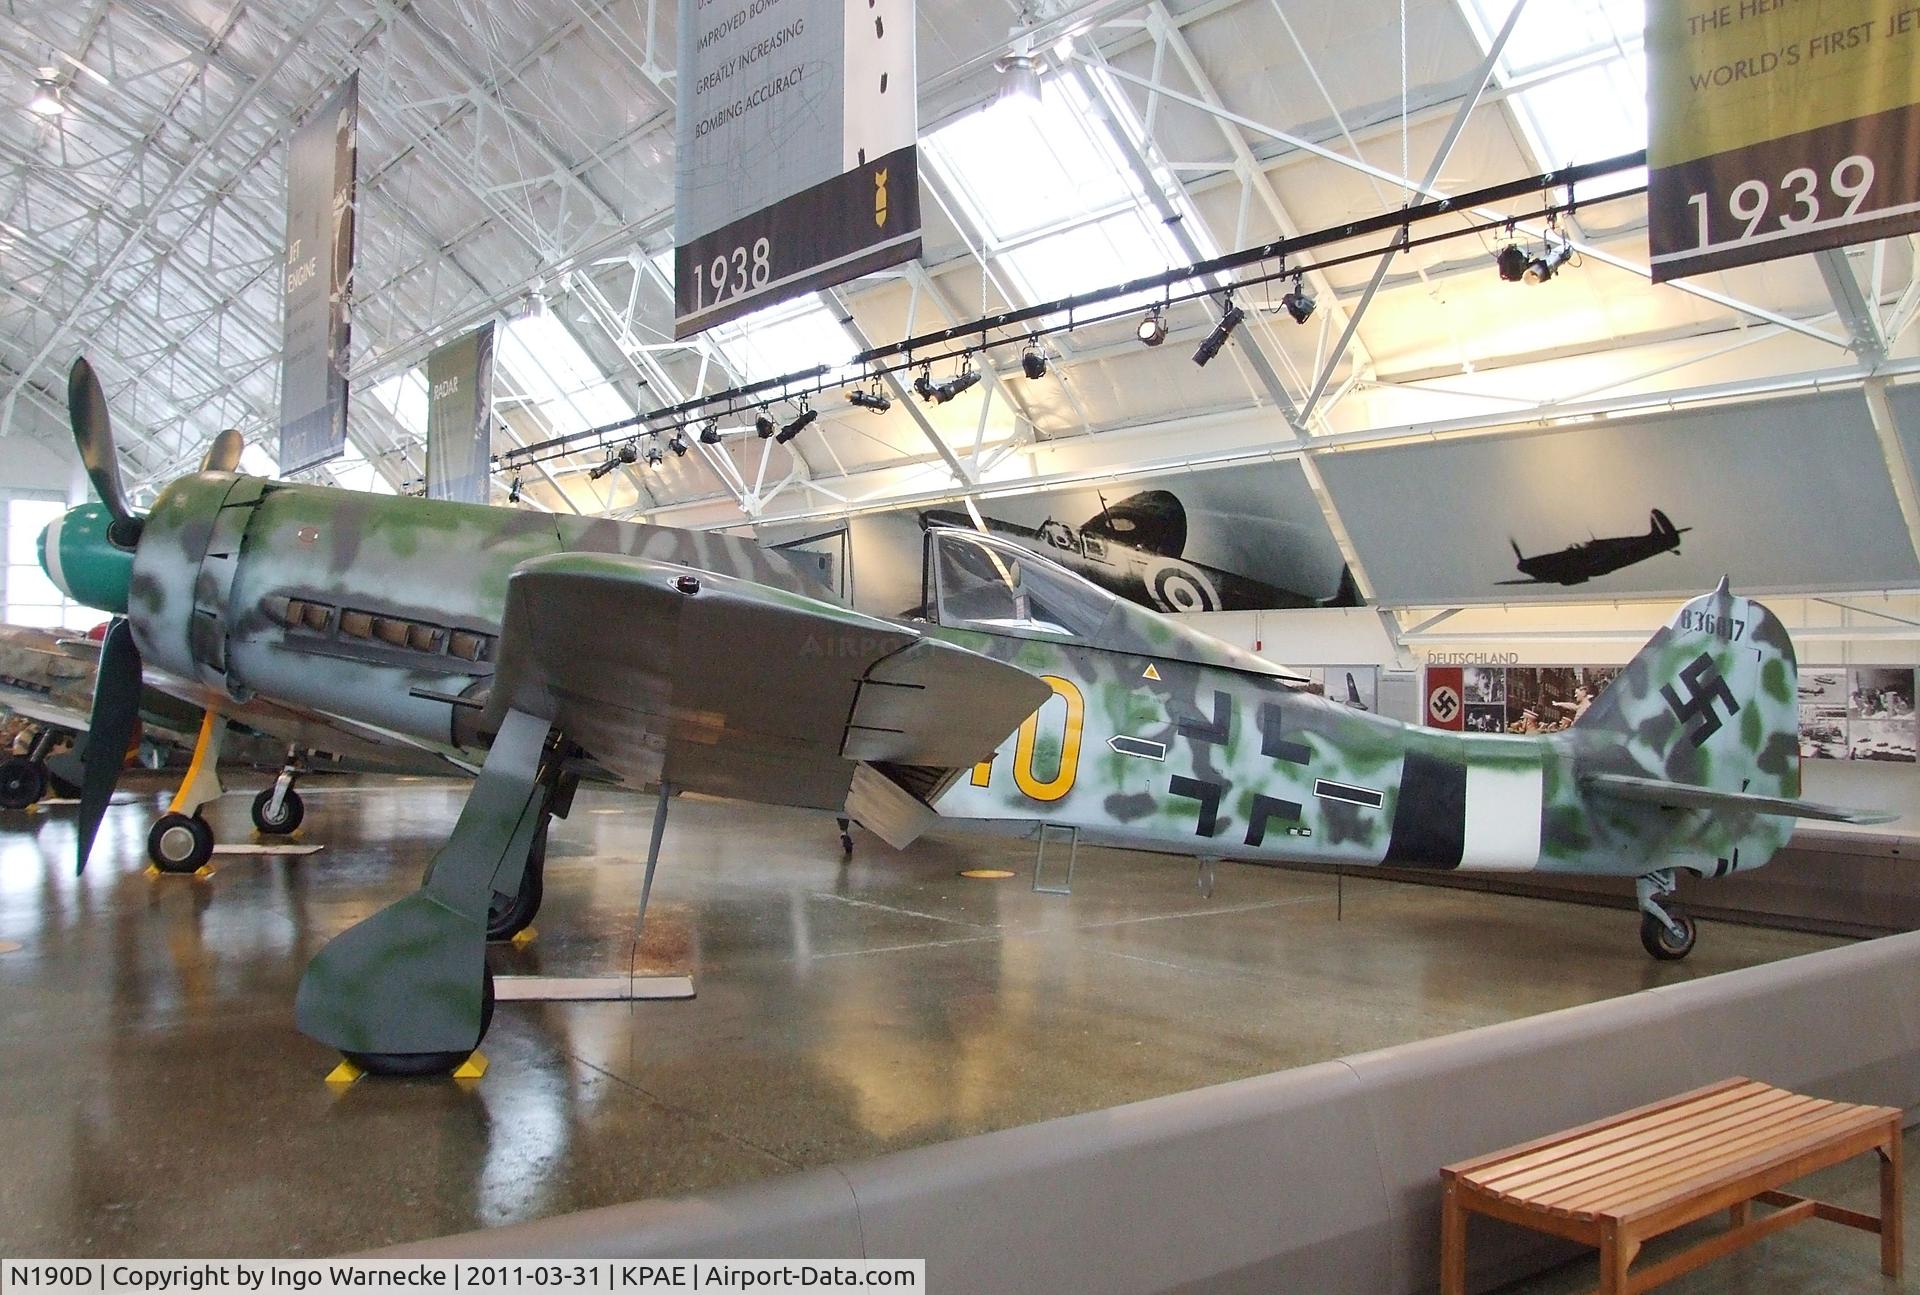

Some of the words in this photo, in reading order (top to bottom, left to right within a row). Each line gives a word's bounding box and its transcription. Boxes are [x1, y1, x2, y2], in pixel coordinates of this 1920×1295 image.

[696, 10, 747, 53] IMPROVED
[1687, 6, 1732, 36] THE
[695, 57, 736, 95] GREATLY
[738, 18, 805, 71] INCREASING
[1690, 45, 1801, 92] WORLD'S
[1809, 20, 1876, 59] FIRST
[695, 98, 743, 138] BOMBING
[744, 64, 806, 112] ACCURACY
[1687, 154, 1876, 249] 1939
[287, 256, 317, 293] ENGINE
[693, 237, 771, 311] 1938
[433, 375, 459, 401] RADAR
[1427, 652, 1519, 665] DEUTSCHLAND
